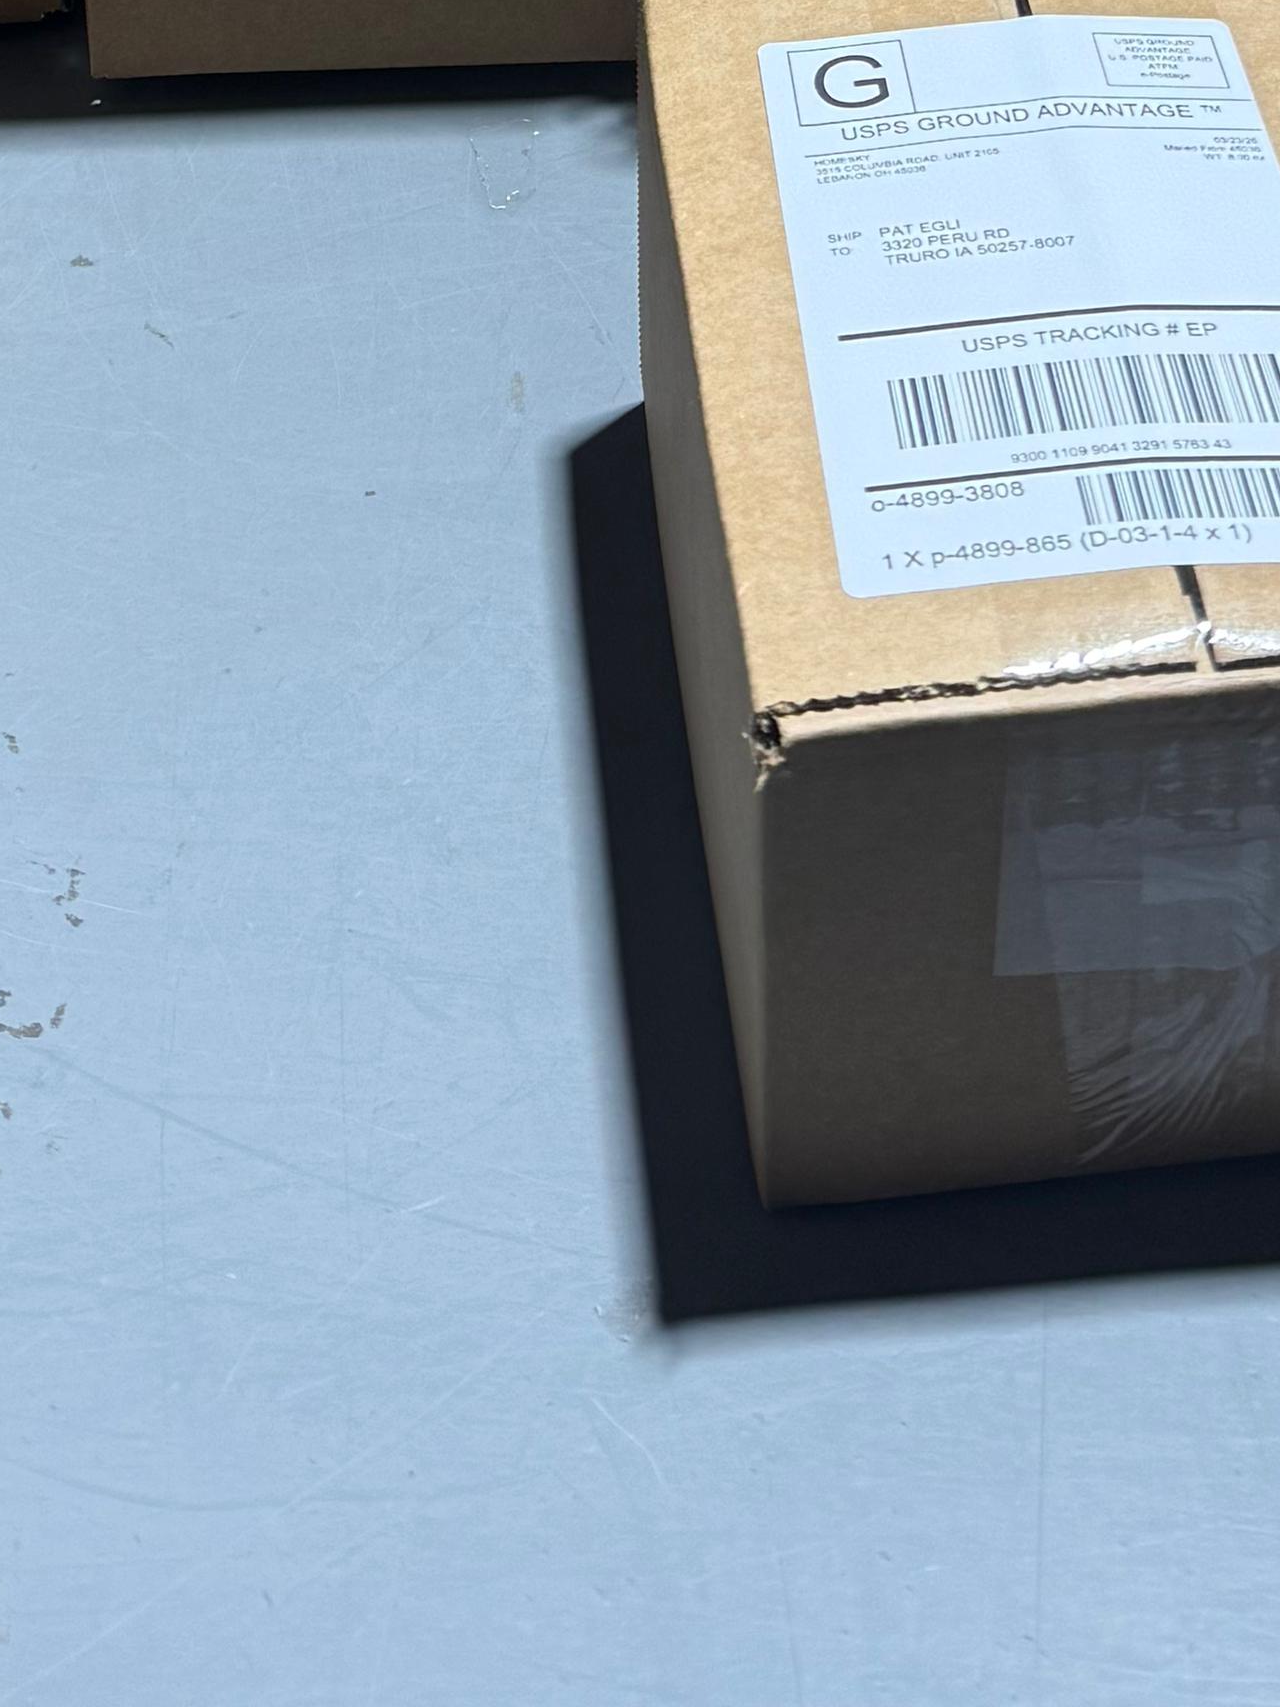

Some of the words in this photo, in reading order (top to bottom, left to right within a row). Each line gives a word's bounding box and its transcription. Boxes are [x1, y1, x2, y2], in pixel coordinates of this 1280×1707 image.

[814, 54, 890, 109] G
[840, 121, 910, 141] USPS
[917, 107, 1030, 132] GROUND
[1037, 101, 1195, 119] ADVANTAGE
[827, 230, 862, 244] SHIP
[878, 224, 913, 238] PAT
[919, 218, 961, 234] EGLI
[829, 246, 851, 257] TO
[881, 237, 922, 252] 3320
[927, 231, 978, 247] PERU
[983, 228, 1010, 240] RD
[884, 248, 950, 266] TRURO
[955, 245, 973, 258] IA
[977, 235, 1075, 255] 50257-8007
[961, 333, 1029, 353] USPS
[1033, 322, 1160, 345] TRACKING
[1165, 323, 1180, 336] #
[1185, 322, 1218, 337] EP
[1010, 450, 1047, 464] 9300
[1052, 445, 1088, 459] 1109
[1091, 441, 1127, 456] 9041
[1132, 439, 1168, 452] 3291
[1213, 438, 1232, 449] 43
[871, 480, 1025, 512] o-4899-3808
[882, 553, 894, 570] 1
[903, 549, 925, 568] X
[930, 533, 1072, 569] p-4899-865
[1079, 524, 1197, 553] (D-03-1-4
[1205, 526, 1221, 541] x
[1232, 522, 1253, 544] 1)
